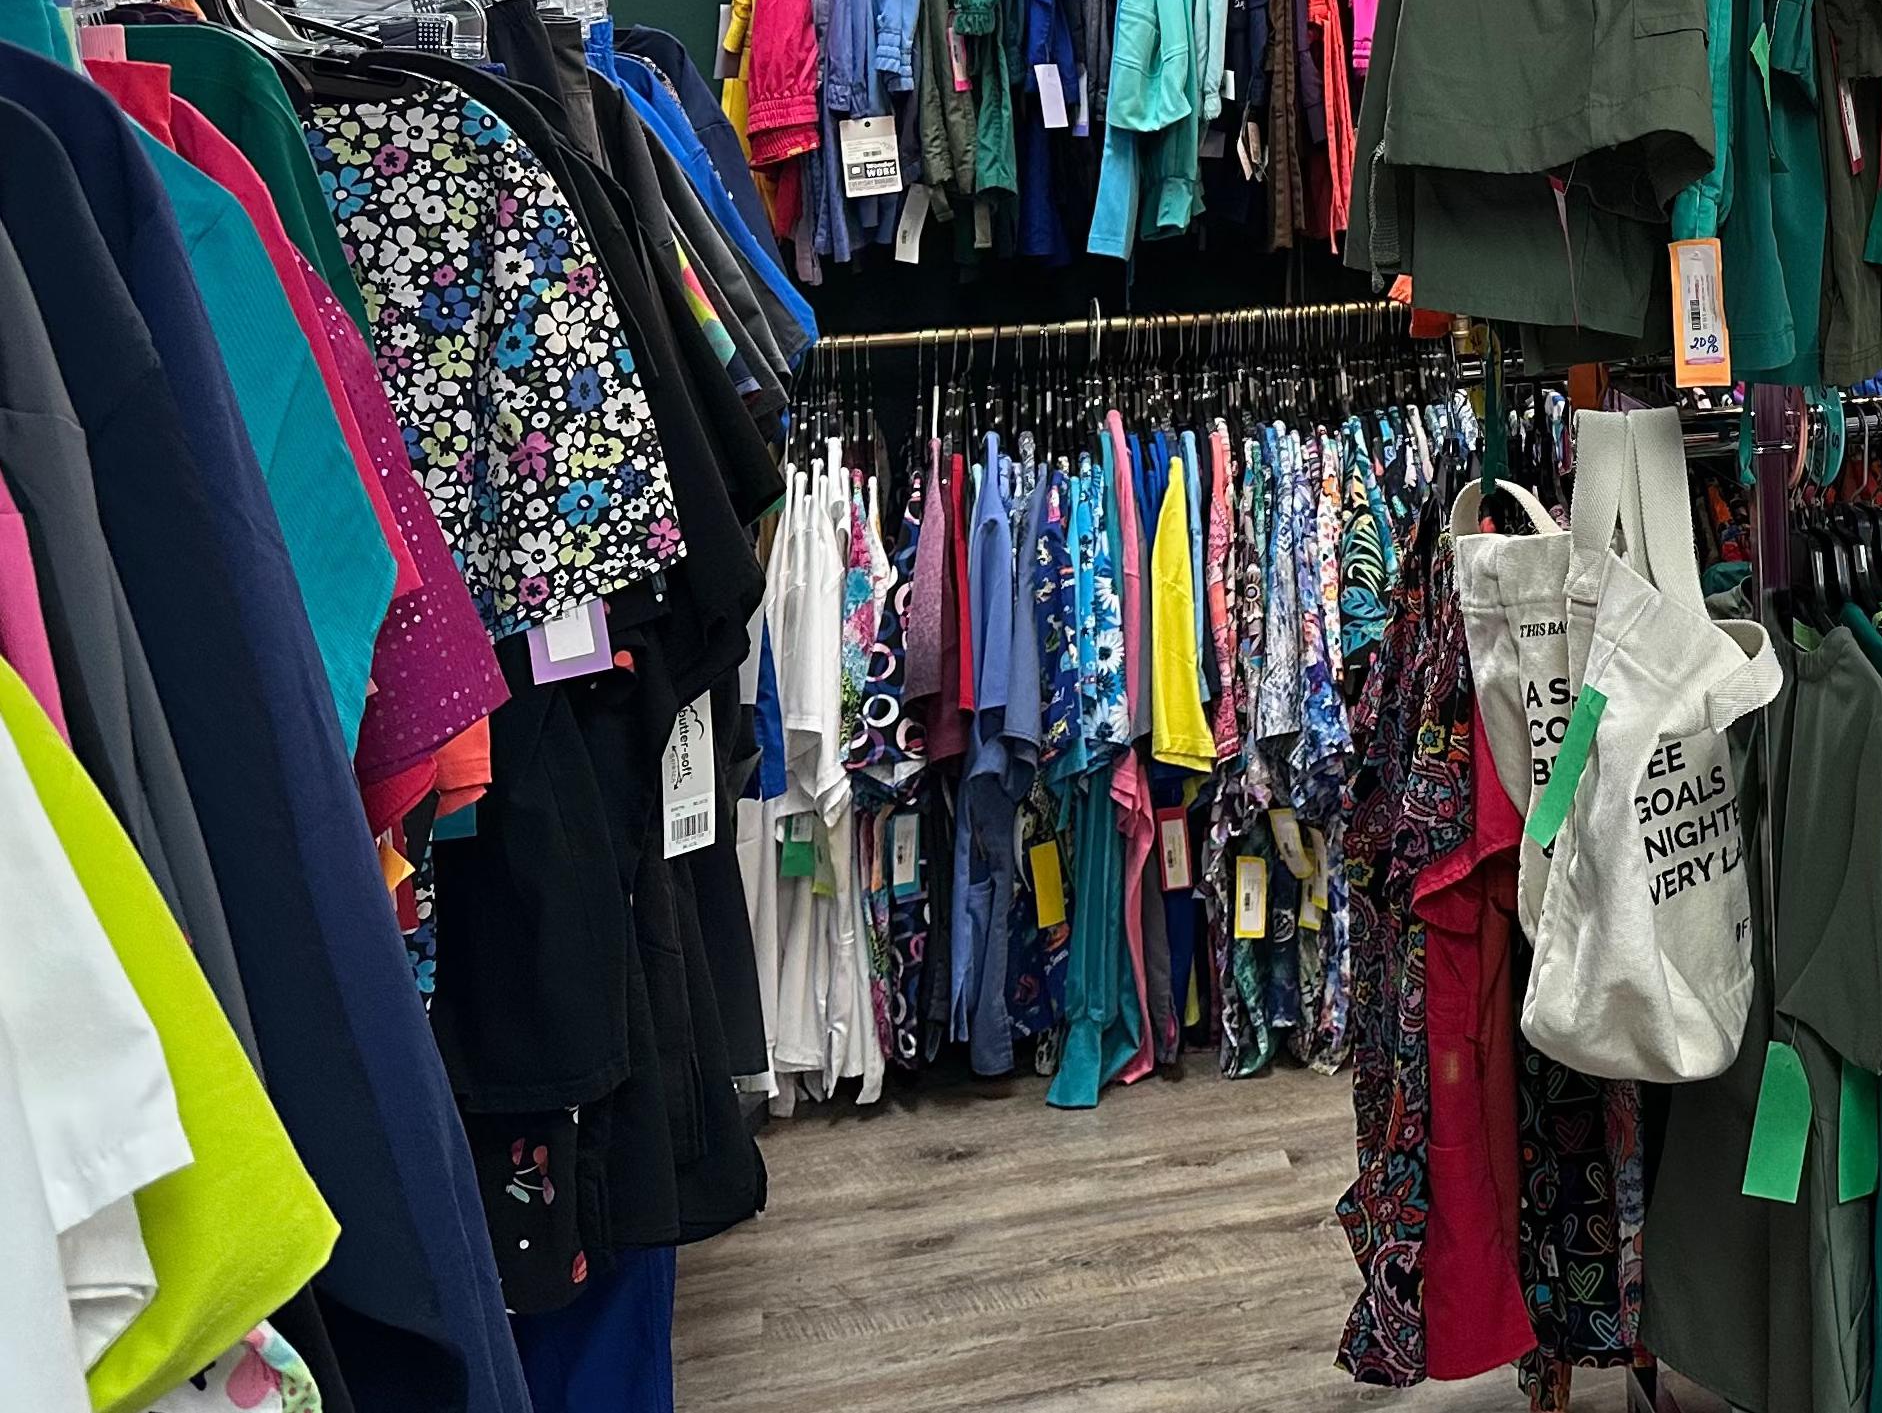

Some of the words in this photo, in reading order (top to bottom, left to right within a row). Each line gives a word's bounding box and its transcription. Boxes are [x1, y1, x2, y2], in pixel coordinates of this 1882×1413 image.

[1520, 622, 1546, 638] THIS
[1526, 681, 1543, 708] A
[678, 708, 692, 778] butter-soft
[1634, 766, 1725, 824] GOALS
